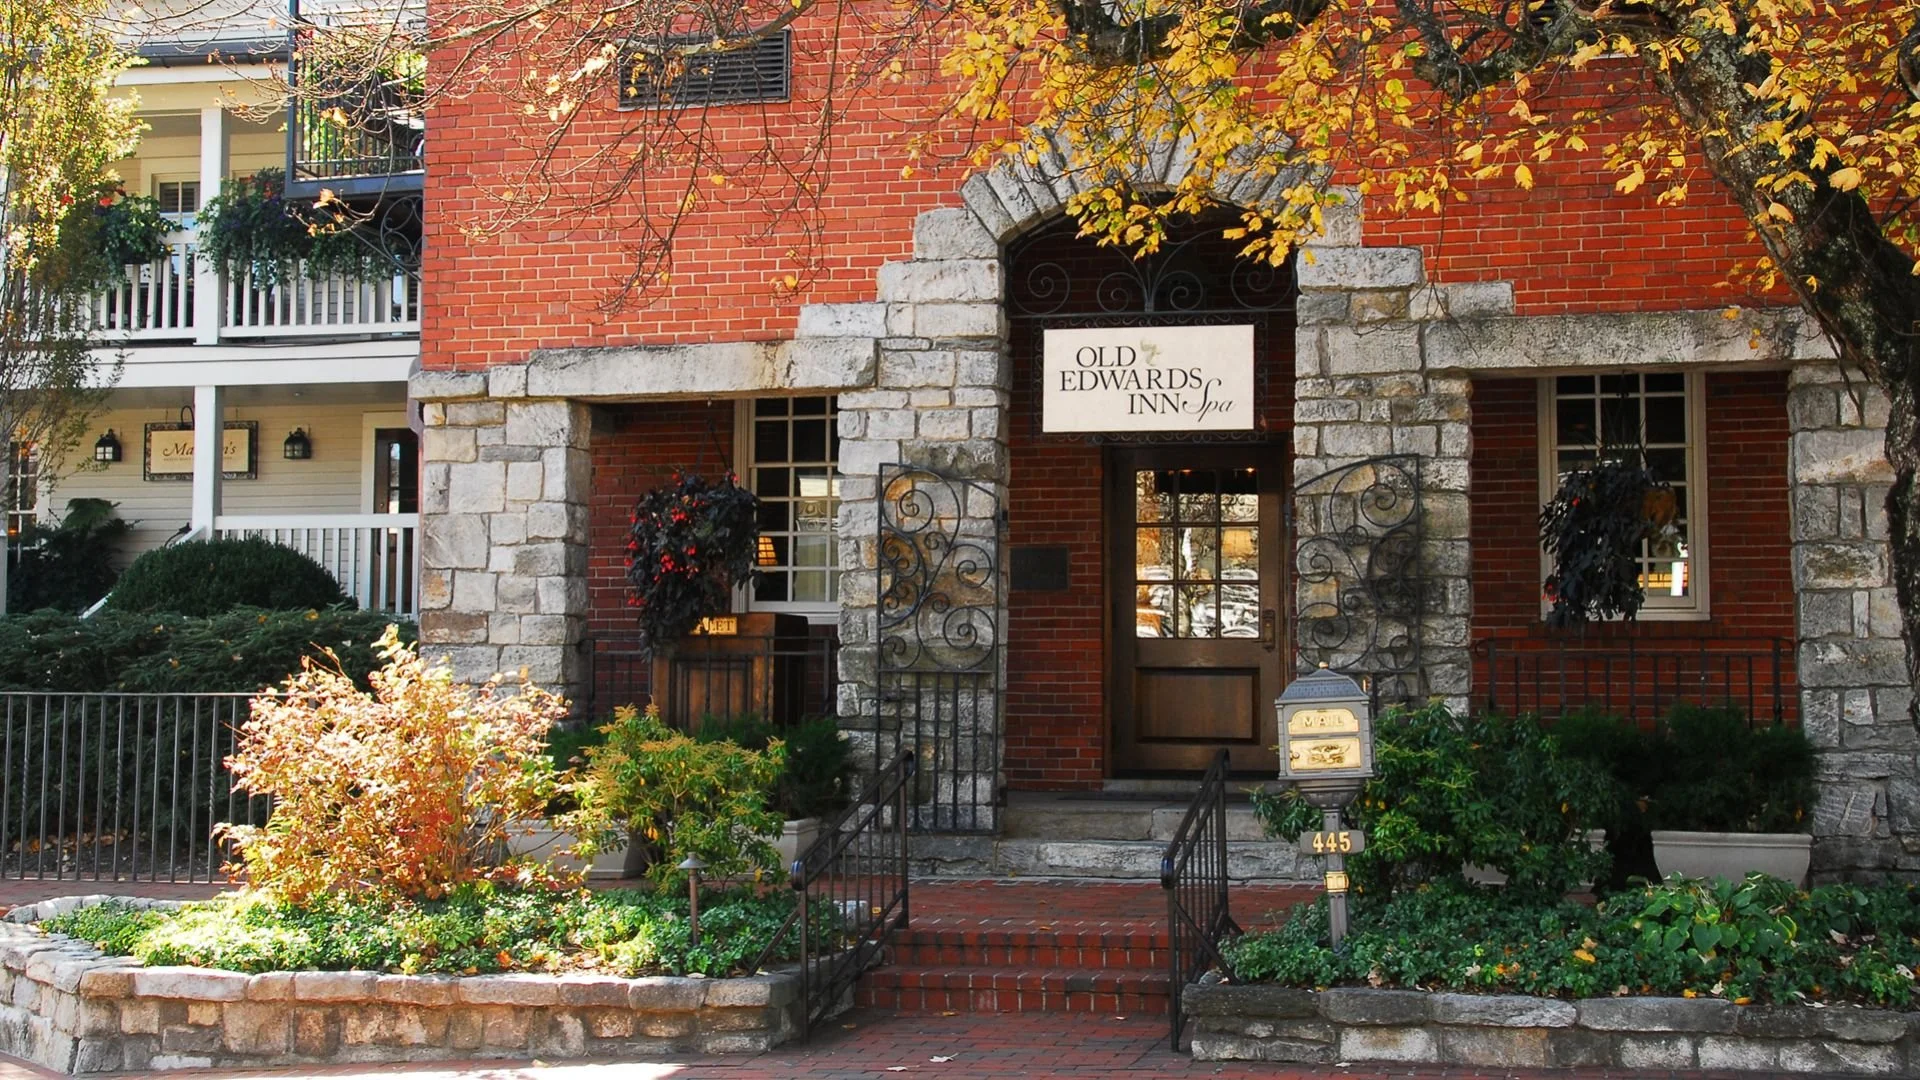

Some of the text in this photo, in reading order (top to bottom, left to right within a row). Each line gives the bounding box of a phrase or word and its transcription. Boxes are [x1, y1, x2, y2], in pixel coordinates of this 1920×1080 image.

[1076, 346, 1137, 368] OLD
[1059, 367, 1202, 392] EDWARDS
[1127, 378, 1236, 423] INN Spa
[1303, 715, 1344, 728] MAIL
[1312, 832, 1352, 853] 445
